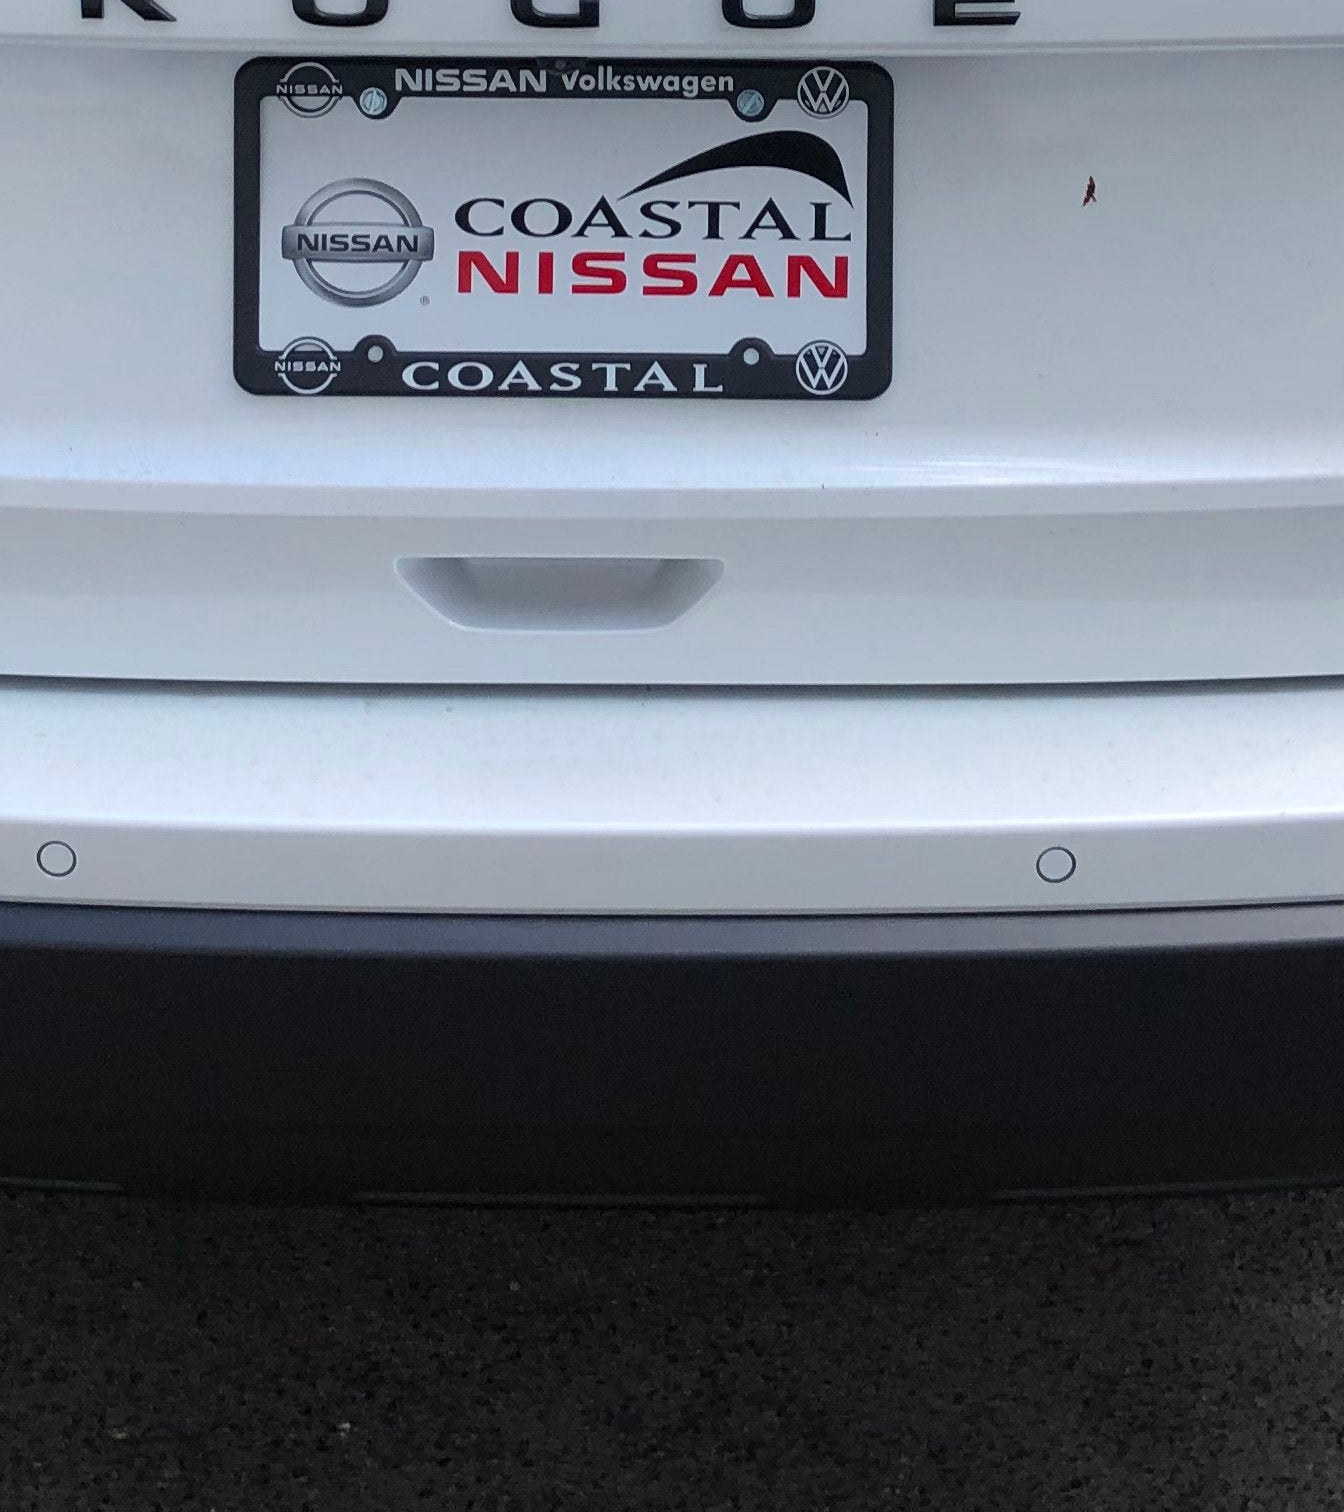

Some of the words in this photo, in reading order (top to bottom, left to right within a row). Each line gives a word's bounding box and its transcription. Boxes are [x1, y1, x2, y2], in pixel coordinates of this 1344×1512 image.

[276, 84, 343, 94] NISSAN
[394, 68, 547, 93] NISSAN
[561, 66, 734, 97] Volkswagen
[454, 195, 852, 241] COASTAL
[297, 233, 419, 253] NISSAN
[457, 250, 849, 298] NISSAN
[274, 361, 341, 372] NISSAN
[401, 360, 724, 393] COASTAL
